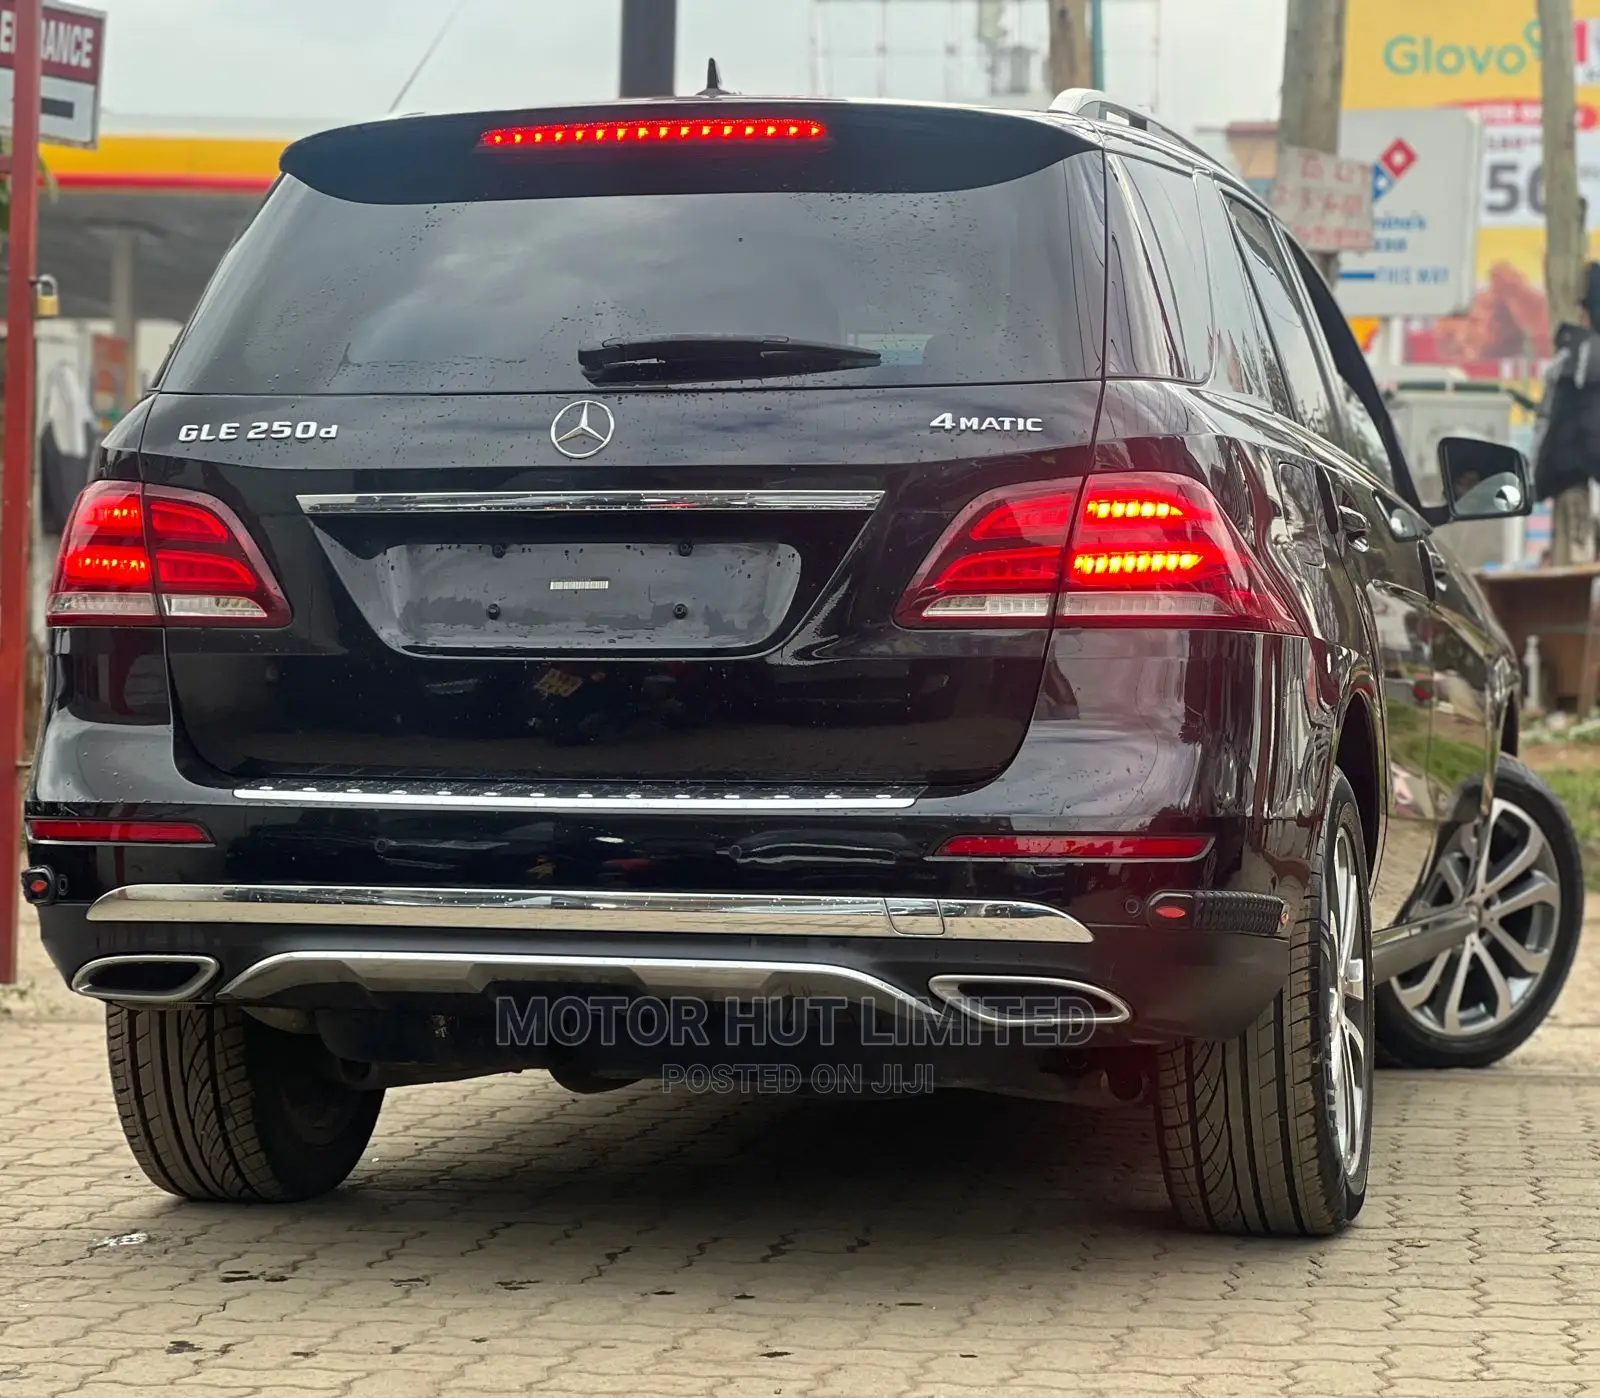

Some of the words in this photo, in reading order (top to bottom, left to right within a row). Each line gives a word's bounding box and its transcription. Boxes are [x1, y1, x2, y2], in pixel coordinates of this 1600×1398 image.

[0, 10, 94, 69] EANCE
[1383, 34, 1527, 76] Glovo
[178, 422, 241, 443] GLE
[246, 420, 340, 441] 250d
[929, 412, 1044, 433] 4MATIC
